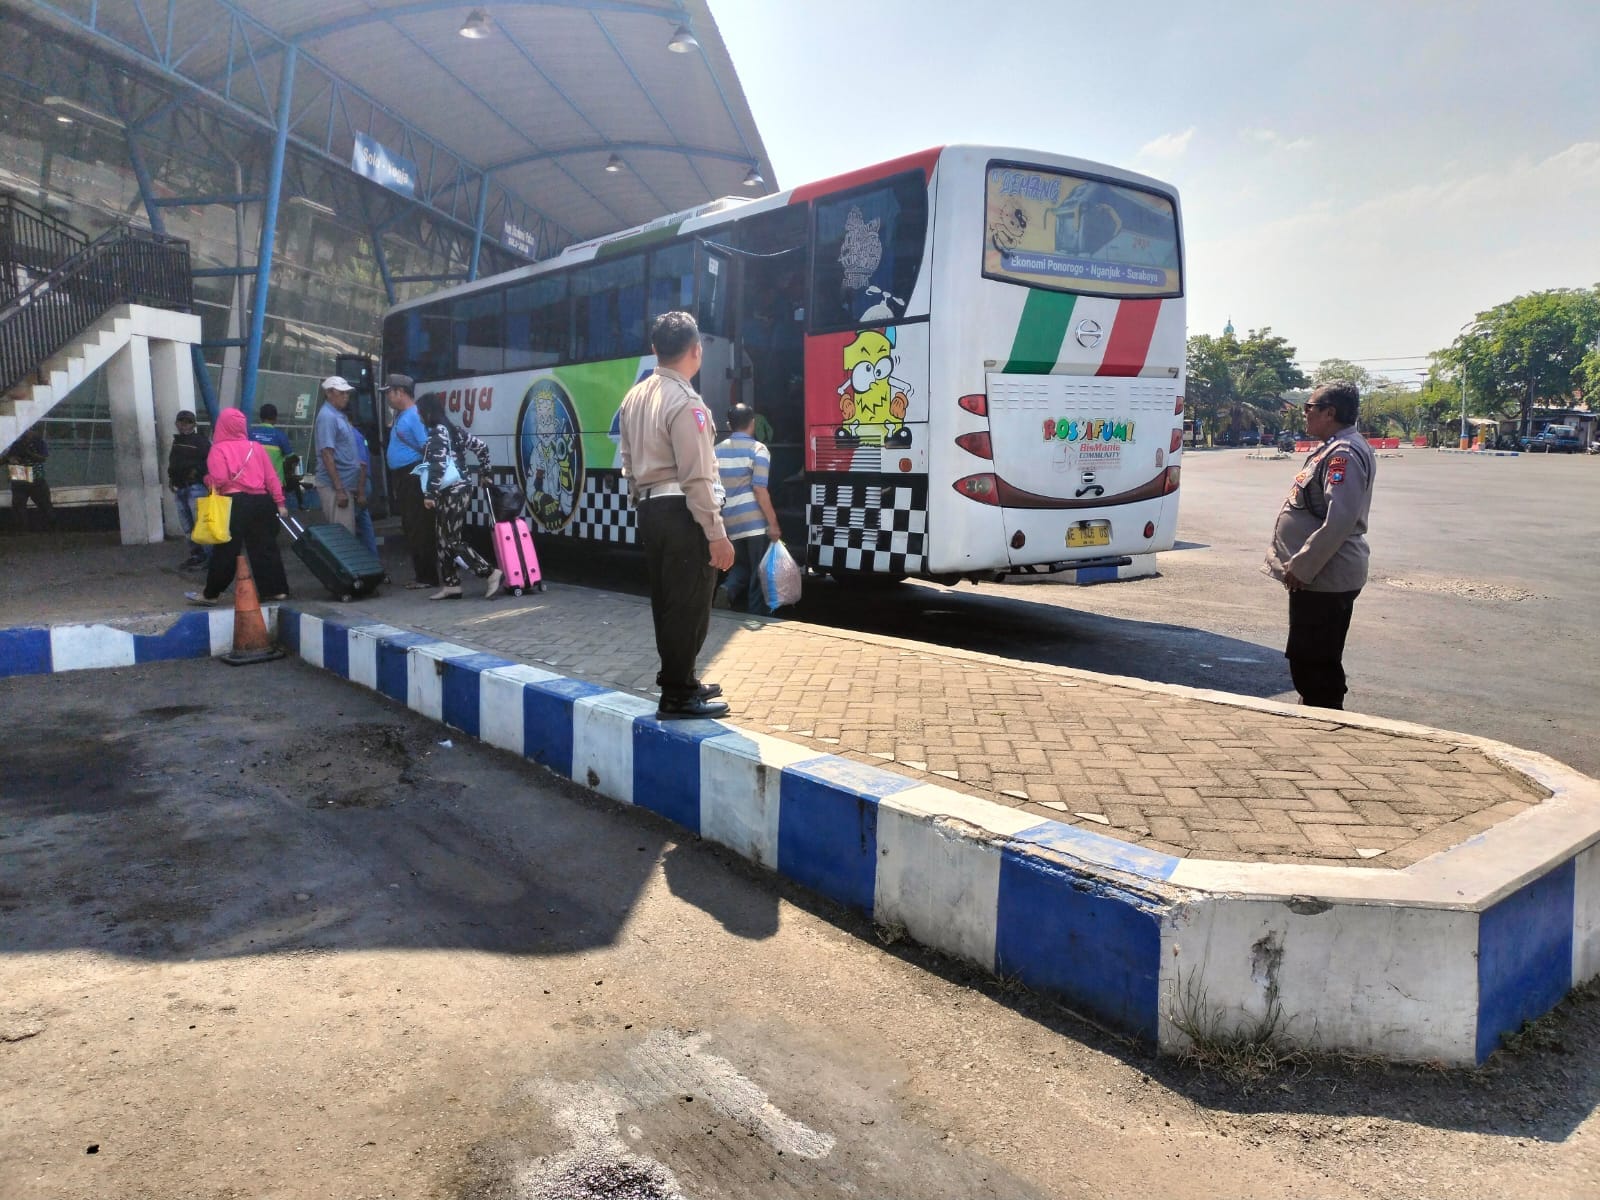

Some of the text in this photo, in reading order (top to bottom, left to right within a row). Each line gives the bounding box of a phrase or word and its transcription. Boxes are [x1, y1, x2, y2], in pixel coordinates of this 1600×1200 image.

[1011, 255, 1046, 270] Ekonomi
[1047, 260, 1084, 275] Ponorogo
[1091, 264, 1121, 279] Nganjuk
[1127, 268, 1158, 284] Surabaya
[1079, 451, 1121, 459] COMMUNITY
